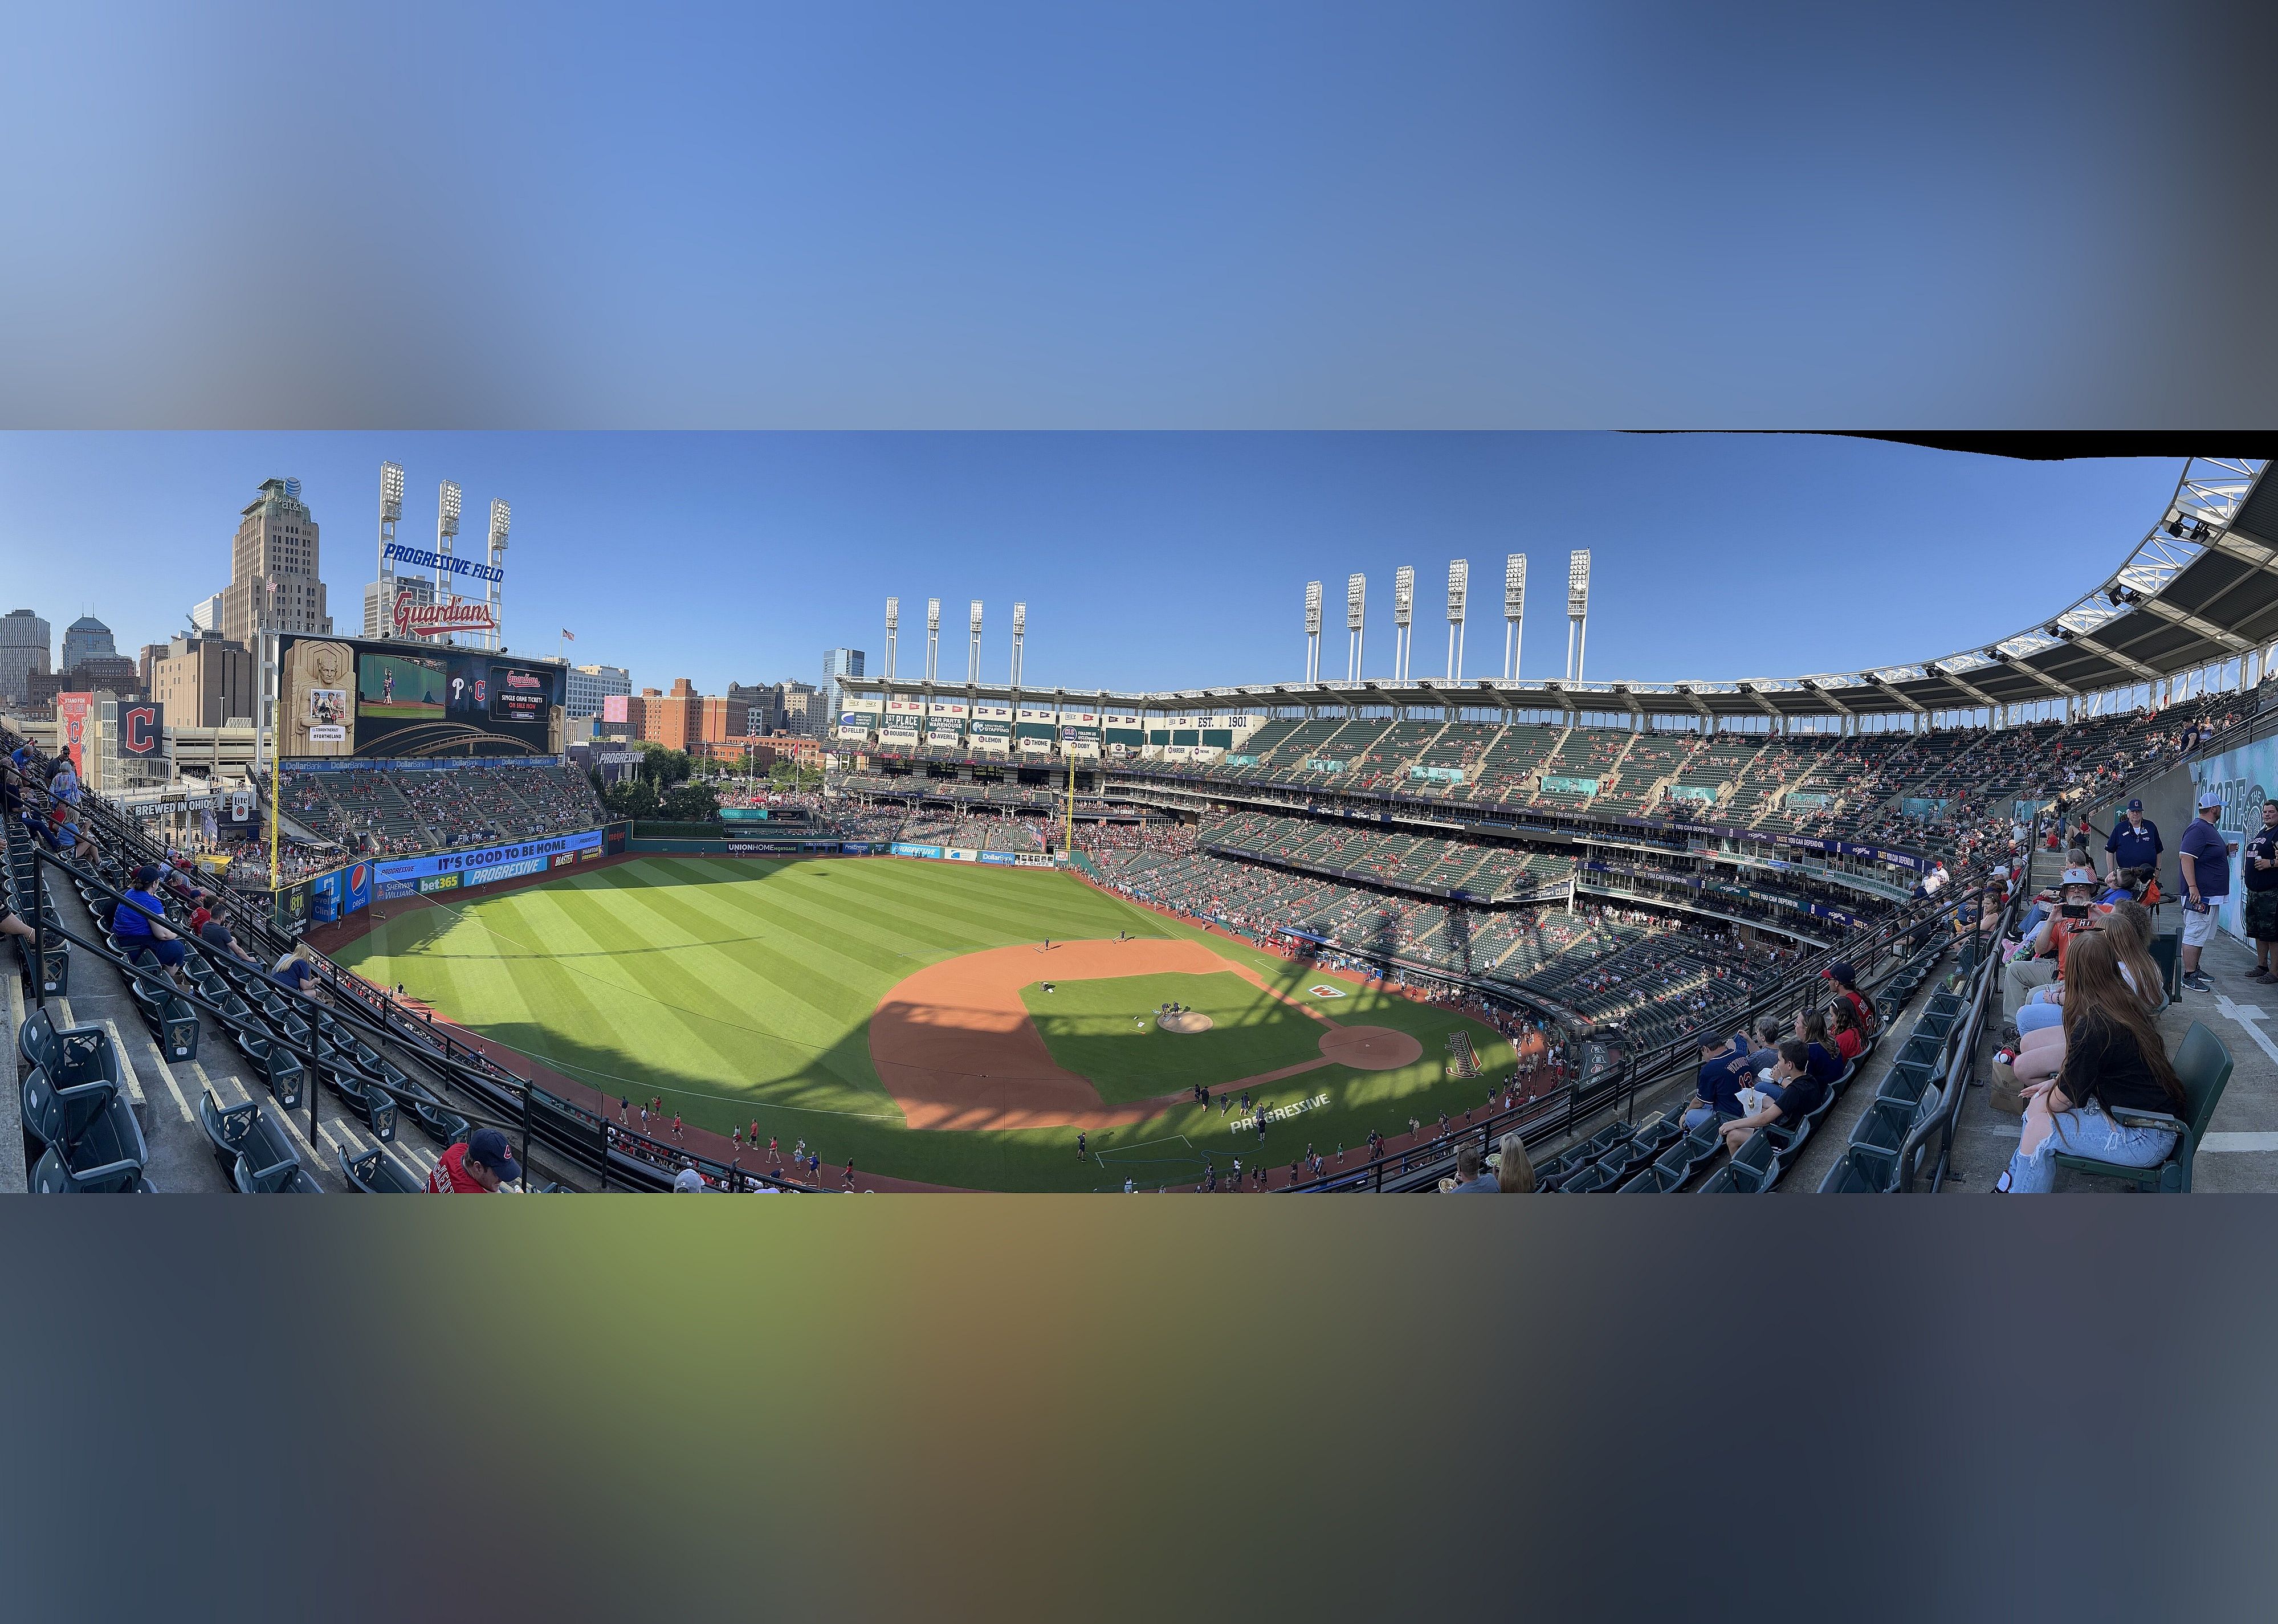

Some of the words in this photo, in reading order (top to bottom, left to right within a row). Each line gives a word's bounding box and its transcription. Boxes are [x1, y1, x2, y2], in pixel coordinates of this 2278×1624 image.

[282, 500, 303, 512] at&t
[383, 542, 471, 576] PROGRESSIVE
[471, 563, 504, 583] FIELD
[393, 591, 495, 637] Guardians
[507, 670, 540, 688] Guardians
[885, 715, 895, 724] 1ST
[896, 715, 918, 725] PLACE
[1198, 717, 1214, 727] EST.
[1228, 716, 1246, 727] 1901
[70, 720, 79, 744] C
[125, 707, 156, 753] C
[598, 752, 645, 764] PROGRESSIVE
[286, 762, 322, 770] DollarBank
[331, 761, 365, 769] DollarBank
[234, 797, 247, 806] Lite
[2250, 790, 2261, 803] THE
[135, 803, 176, 817] BREWED
[177, 802, 187, 812] IN
[188, 799, 210, 811] OHIO
[1788, 797, 1819, 808] Guardians
[609, 831, 625, 842] meijer
[1804, 839, 1817, 848] DEPEND
[438, 856, 462, 871] IT'S
[466, 850, 502, 865] GOOD
[505, 848, 519, 860] TO
[522, 845, 534, 856] BE
[537, 840, 566, 854] HOME
[582, 852, 598, 860] FIREWORKS
[893, 845, 938, 856] PROGRESSIVE
[555, 854, 574, 867] BLASTER
[983, 853, 1013, 862] DollarBank
[1877, 850, 1886, 859] TASTE
[1898, 855, 1910, 866] DEPEND
[381, 866, 415, 875] PROGRESSIVE
[471, 858, 541, 884] PROGRESSIVE
[386, 881, 414, 891] SHERWIN
[421, 876, 457, 892] bet365
[1555, 887, 1569, 896] CLUB
[291, 894, 303, 911] 811
[352, 896, 366, 909] pepsi
[1778, 897, 1793, 906] DEPEND
[294, 918, 307, 928] before
[1203, 914, 1216, 923] RE/MAX
[1853, 919, 1863, 928] TASTE
[1428, 968, 1472, 980] CLEVELAND
[1445, 1030, 1484, 1079] Guardians
